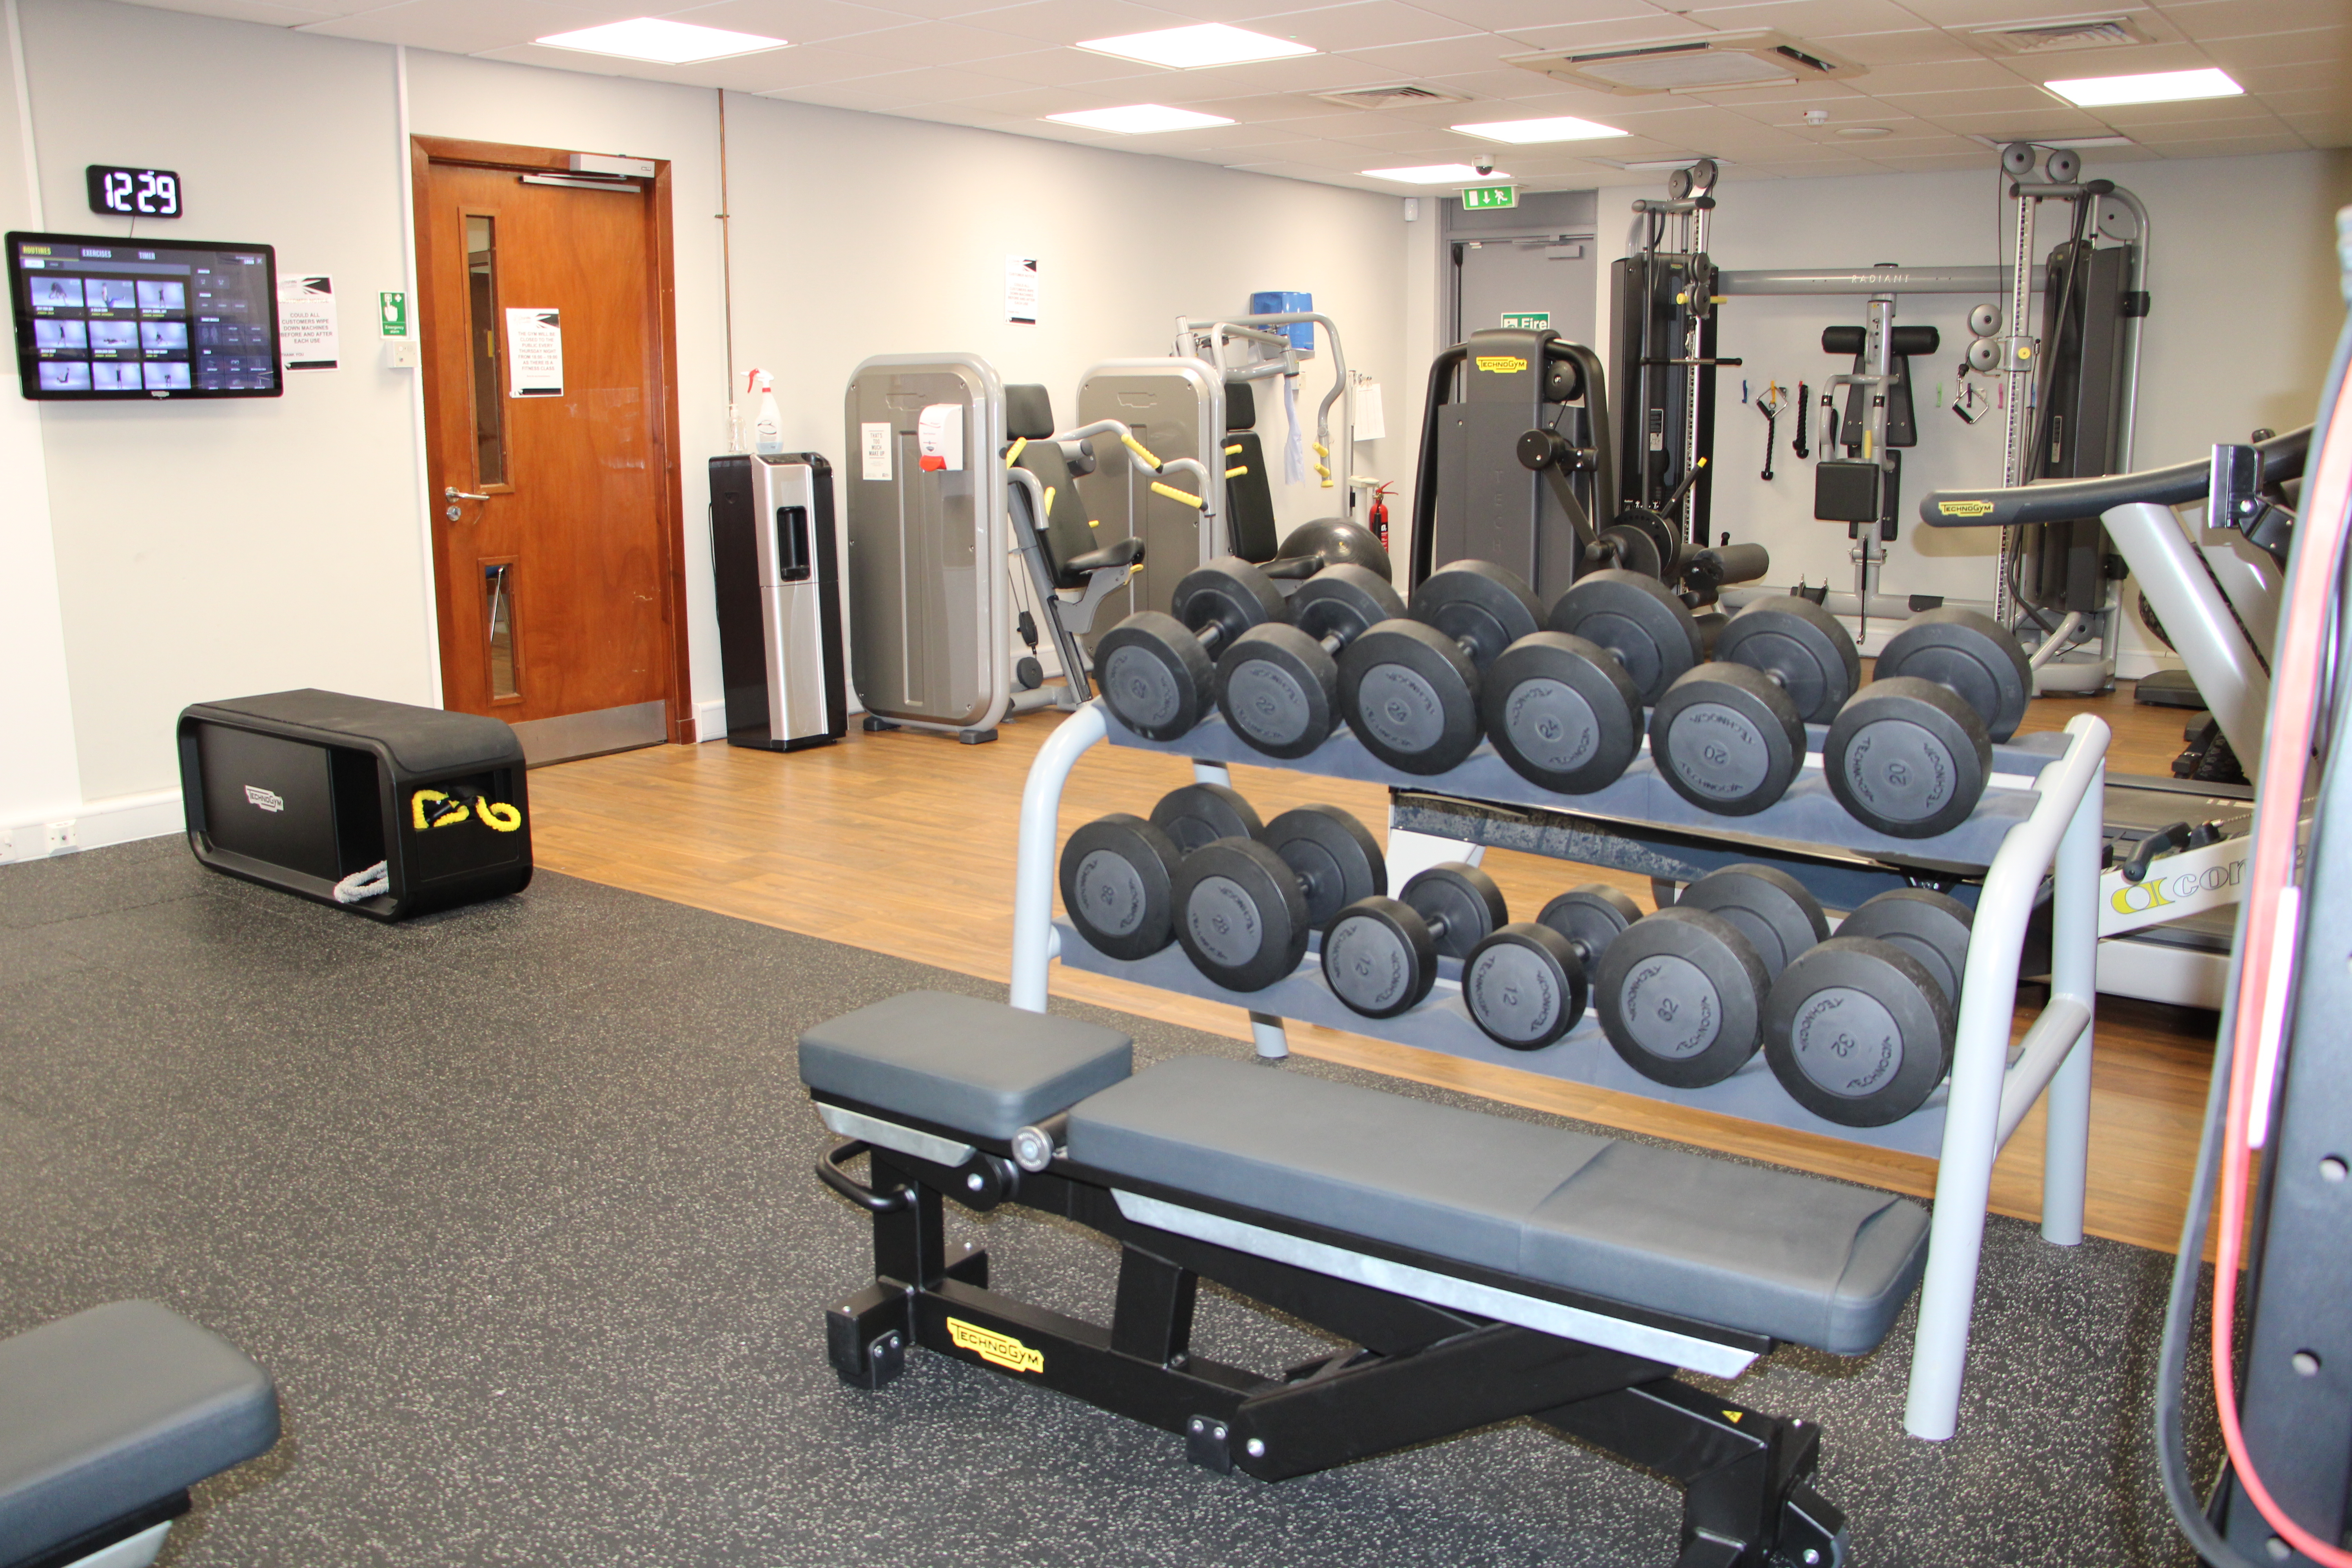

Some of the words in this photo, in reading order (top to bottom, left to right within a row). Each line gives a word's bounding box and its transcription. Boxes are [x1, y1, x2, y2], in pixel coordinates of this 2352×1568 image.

[22, 245, 51, 255] ROUTINES
[82, 248, 112, 258] EXERCISES
[139, 251, 156, 260] TIMER
[1852, 274, 1909, 283] RADIANT
[1521, 318, 1547, 329] Fire
[1132, 679, 1146, 699] 22
[1256, 696, 1275, 715] 22
[1387, 702, 1407, 721] 24
[1539, 719, 1559, 738] 24
[1704, 745, 1727, 764] 20
[1889, 763, 1906, 784] 20
[1100, 885, 1114, 905] 28
[1212, 914, 1230, 935] 28
[1355, 957, 1371, 975] 12
[1503, 987, 1517, 1005] 12
[1831, 1033, 1855, 1057] 32
